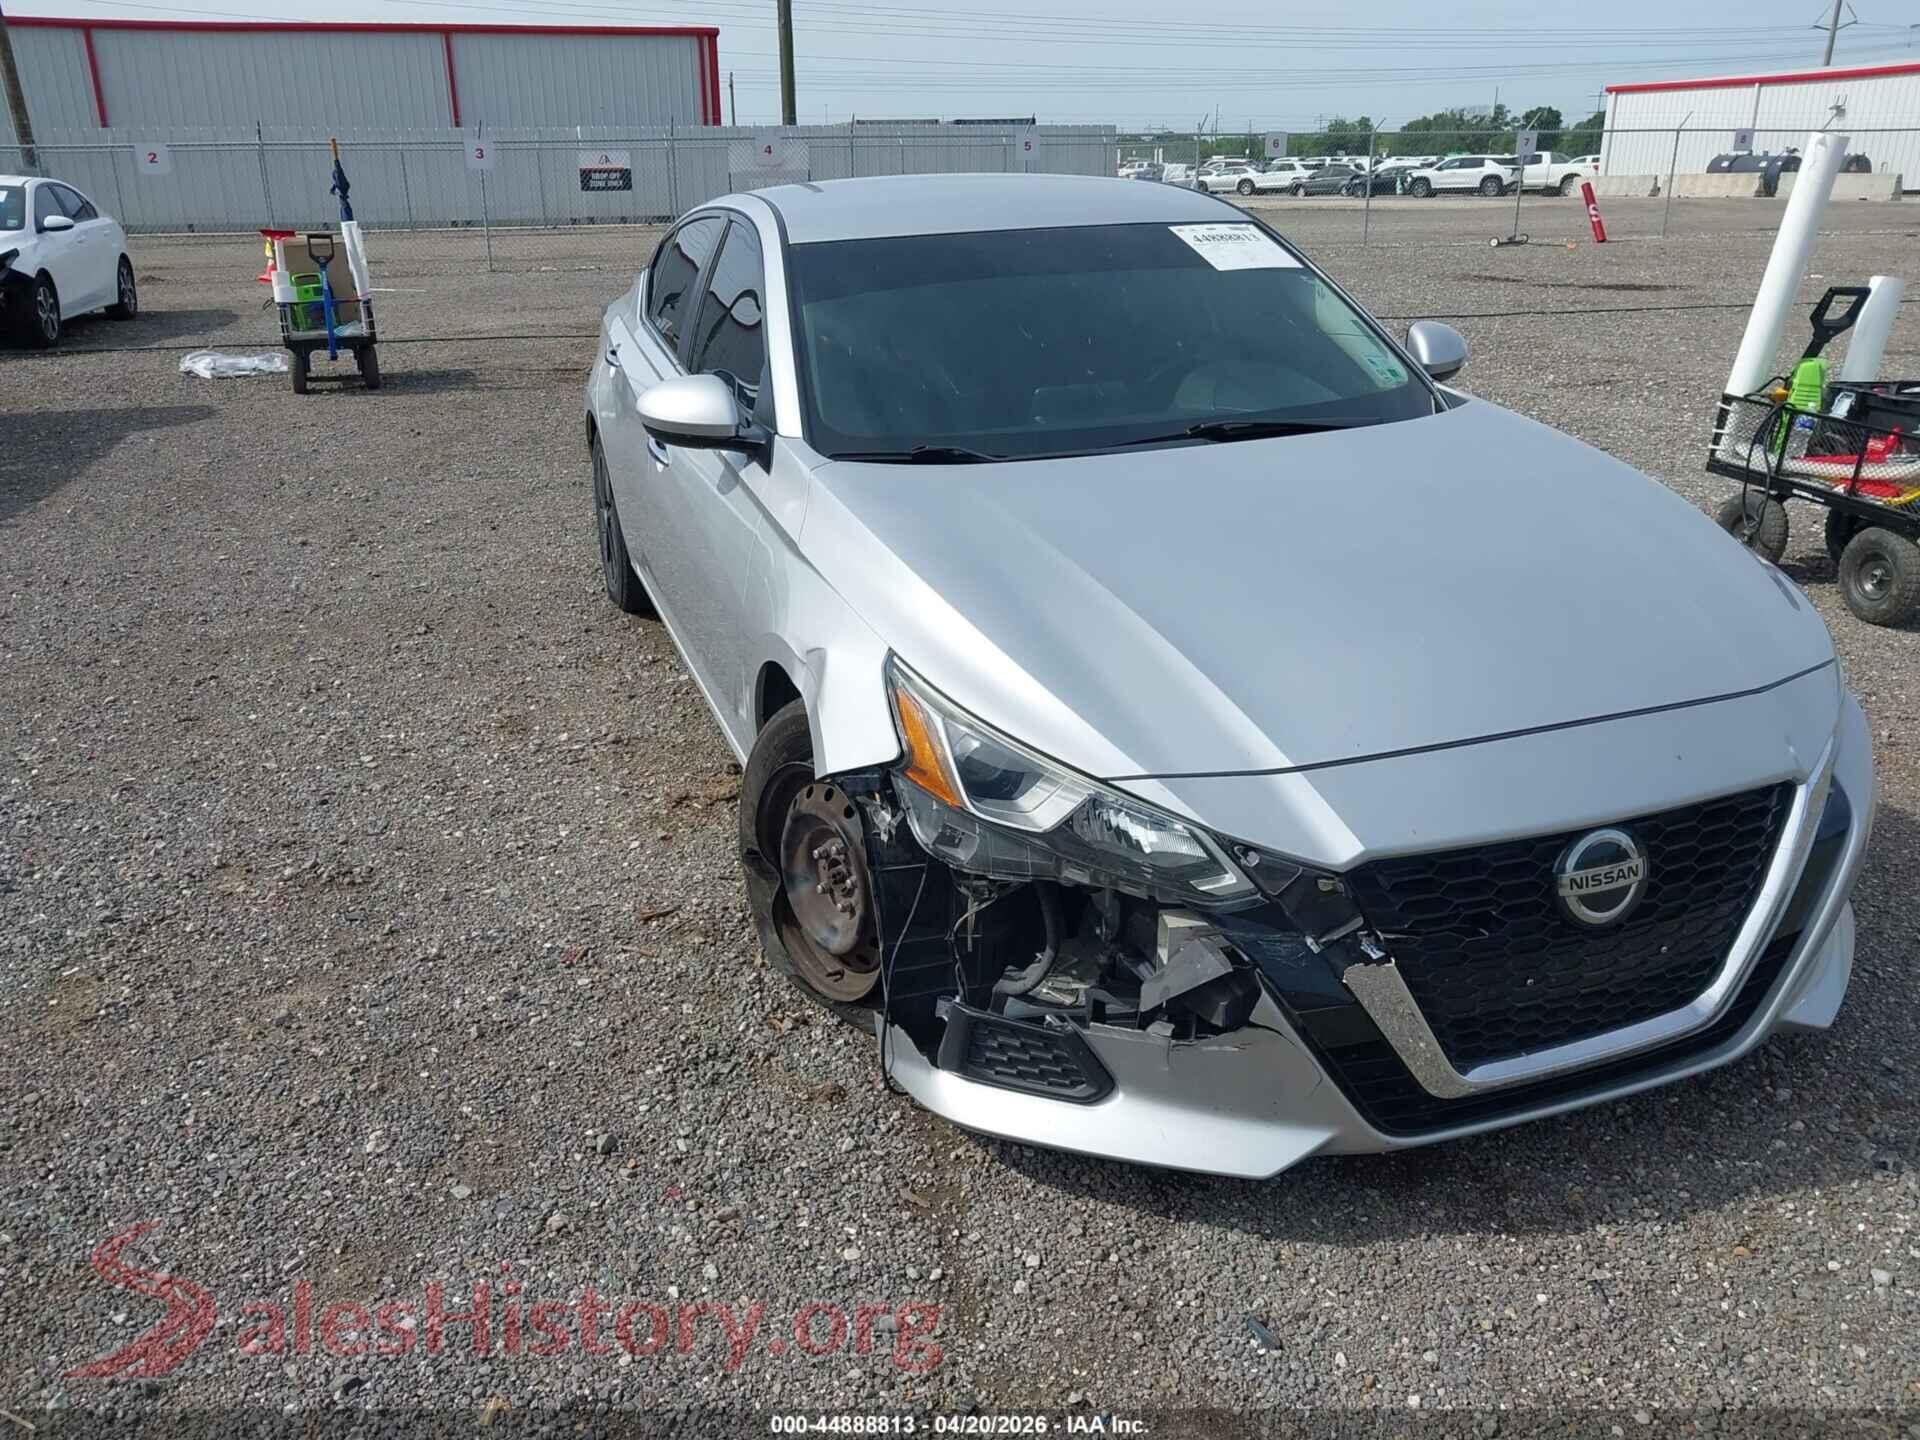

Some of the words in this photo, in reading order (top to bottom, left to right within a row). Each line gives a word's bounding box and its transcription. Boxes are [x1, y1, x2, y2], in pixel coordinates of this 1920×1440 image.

[764, 144, 773, 155] 4
[1024, 141, 1032, 151] 5
[147, 152, 159, 164] 2
[475, 147, 484, 160] 3
[1569, 863, 1640, 891] NISSAN
